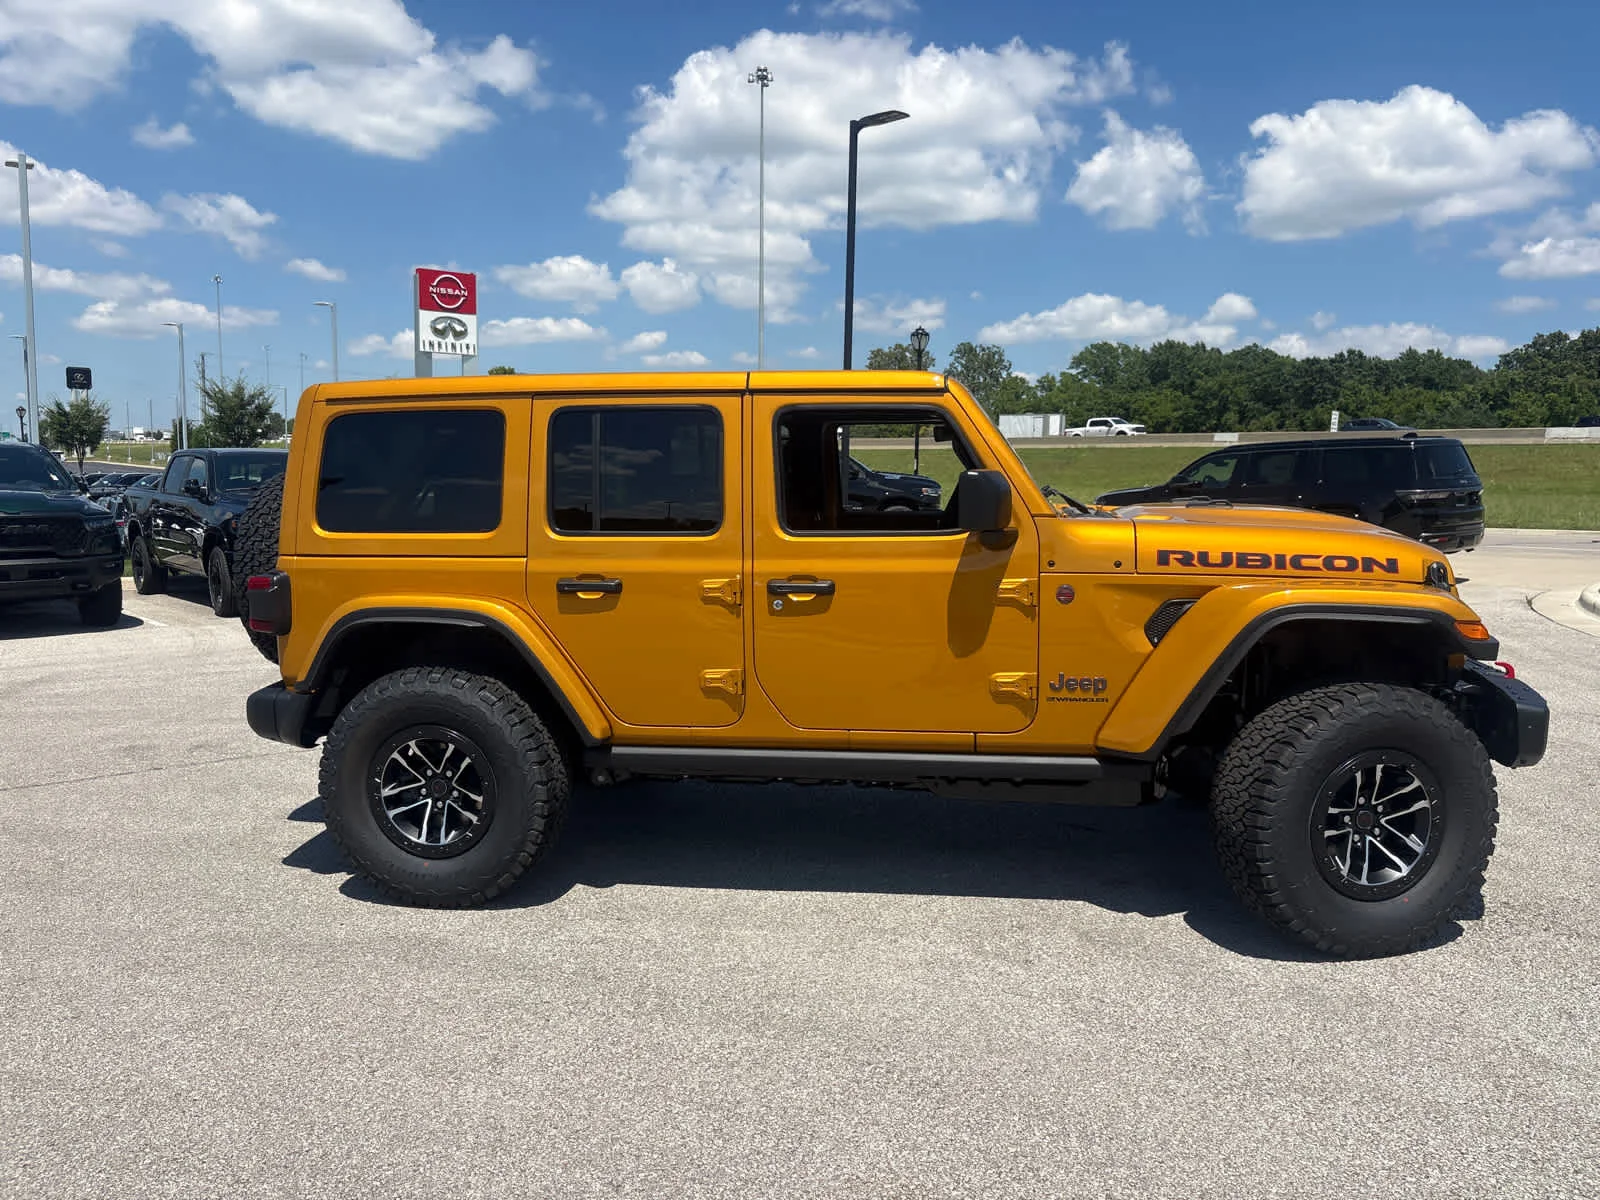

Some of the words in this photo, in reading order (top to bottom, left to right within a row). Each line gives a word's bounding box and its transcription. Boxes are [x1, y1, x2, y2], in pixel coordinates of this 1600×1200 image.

[429, 286, 468, 296] NISSAN
[422, 339, 476, 354] INFINITI
[1157, 549, 1399, 574] RUBICON
[1049, 671, 1107, 695] Jeep
